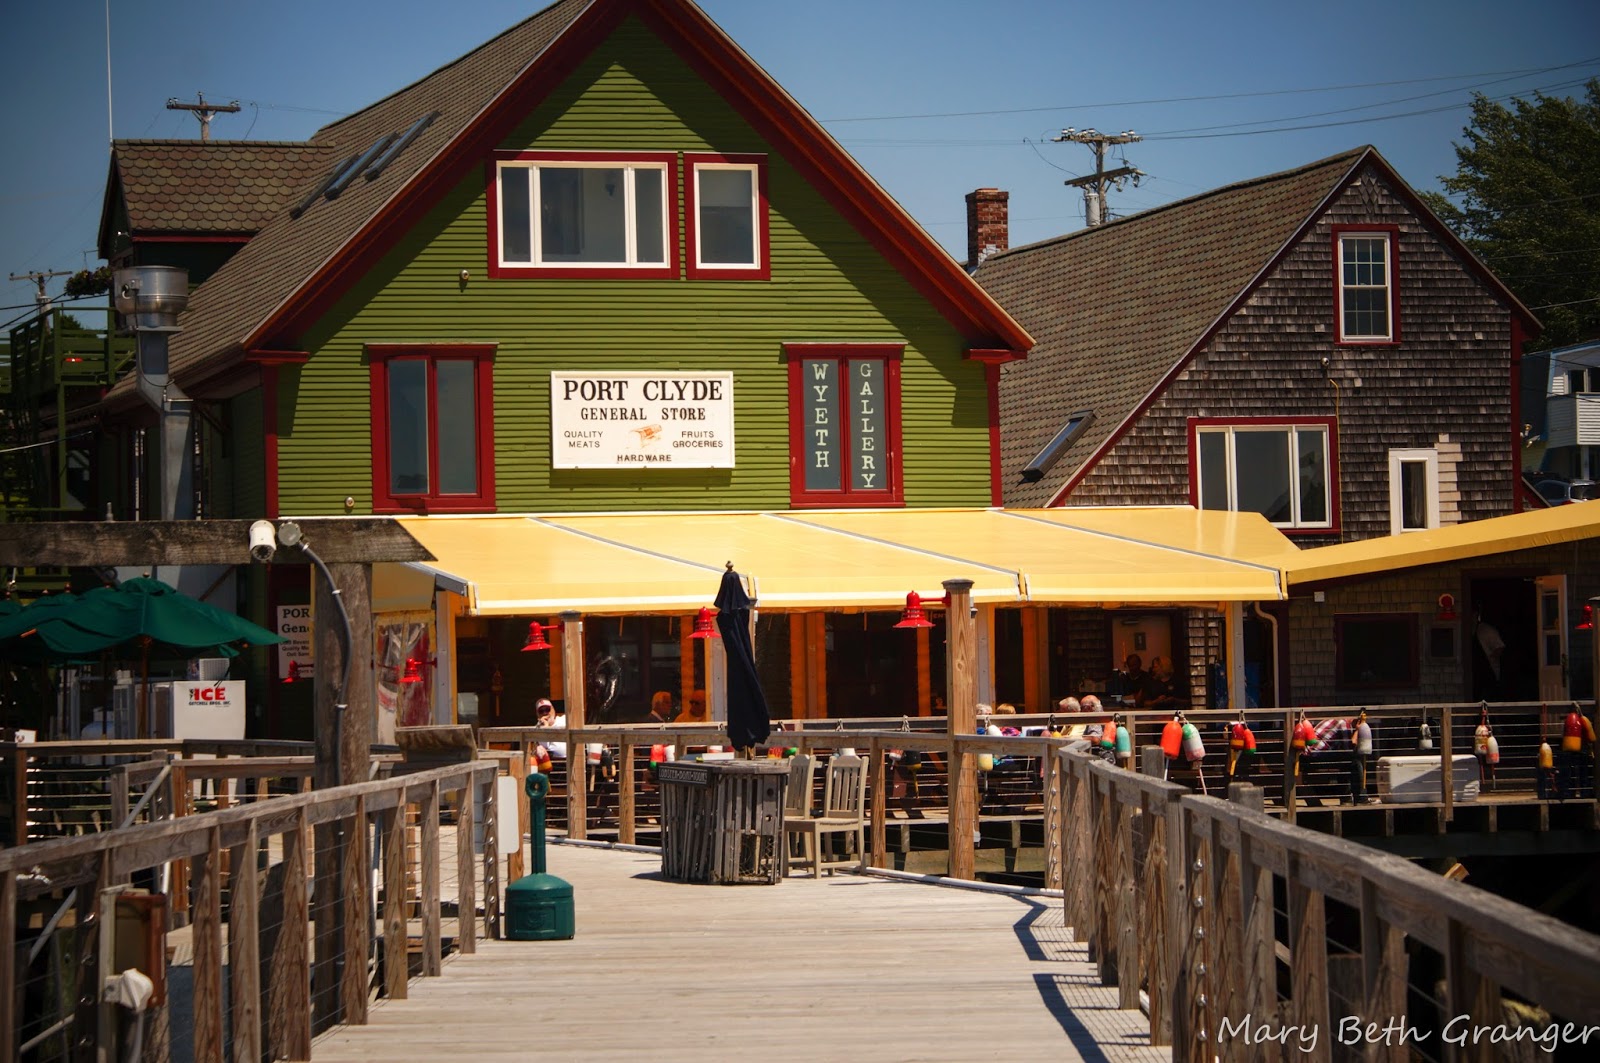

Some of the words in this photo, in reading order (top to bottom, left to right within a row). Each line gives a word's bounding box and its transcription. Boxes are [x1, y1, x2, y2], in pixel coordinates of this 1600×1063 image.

[563, 380, 628, 401] PORT
[643, 380, 723, 401] CLYDE
[581, 407, 647, 420] GENERAL
[661, 407, 706, 420] STORE
[812, 363, 829, 468] WYETH
[860, 363, 875, 488] GALLERY
[564, 430, 603, 439] QUALITY
[681, 430, 714, 438] FRUITS
[568, 440, 601, 448] MEATS
[672, 440, 723, 448] GROCERIES
[616, 454, 672, 462] HARDWARE
[283, 608, 310, 618] POR
[194, 688, 225, 700] ICE
